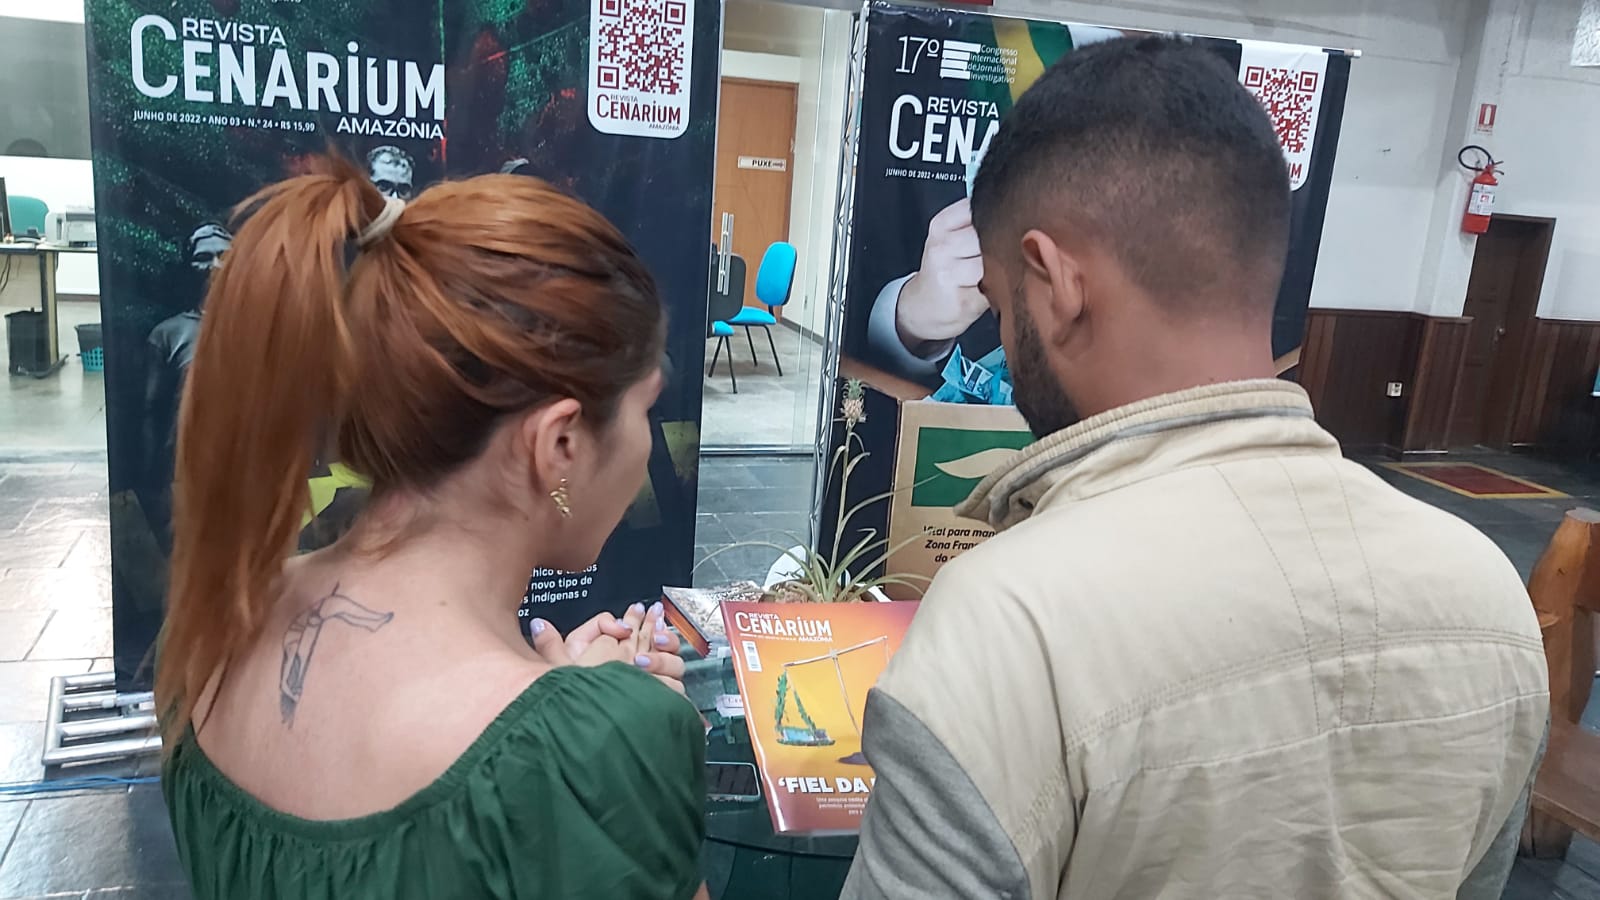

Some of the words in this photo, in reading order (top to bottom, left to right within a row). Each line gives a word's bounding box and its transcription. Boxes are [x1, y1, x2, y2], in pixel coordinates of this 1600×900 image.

[182, 17, 287, 46] REVISTA
[981, 44, 1018, 56] Congresso
[970, 53, 1018, 65] Internacional
[970, 72, 1015, 84] Investigativo
[611, 94, 638, 103] REVISTA
[927, 96, 999, 118] REVISTA
[133, 110, 163, 122] JUNHO
[166, 112, 178, 122] DE
[179, 112, 201, 123] 2022
[208, 115, 228, 125] ANO
[229, 117, 240, 126] 03
[262, 120, 273, 129] 24
[280, 121, 291, 130] R$
[293, 122, 315, 132] 15,99
[336, 116, 445, 140] AMAZÔNIA
[752, 159, 772, 168] PUXE
[885, 167, 907, 177] JUNHO
[908, 170, 917, 178] DE
[935, 172, 949, 181] ANO
[949, 174, 957, 182] 03
[947, 528, 971, 538] para
[925, 539, 950, 550] Zona
[531, 580, 556, 591] novo
[558, 577, 578, 590] tipo
[580, 575, 593, 586] de
[531, 589, 580, 604] indígenas
[835, 777, 870, 793] DA
